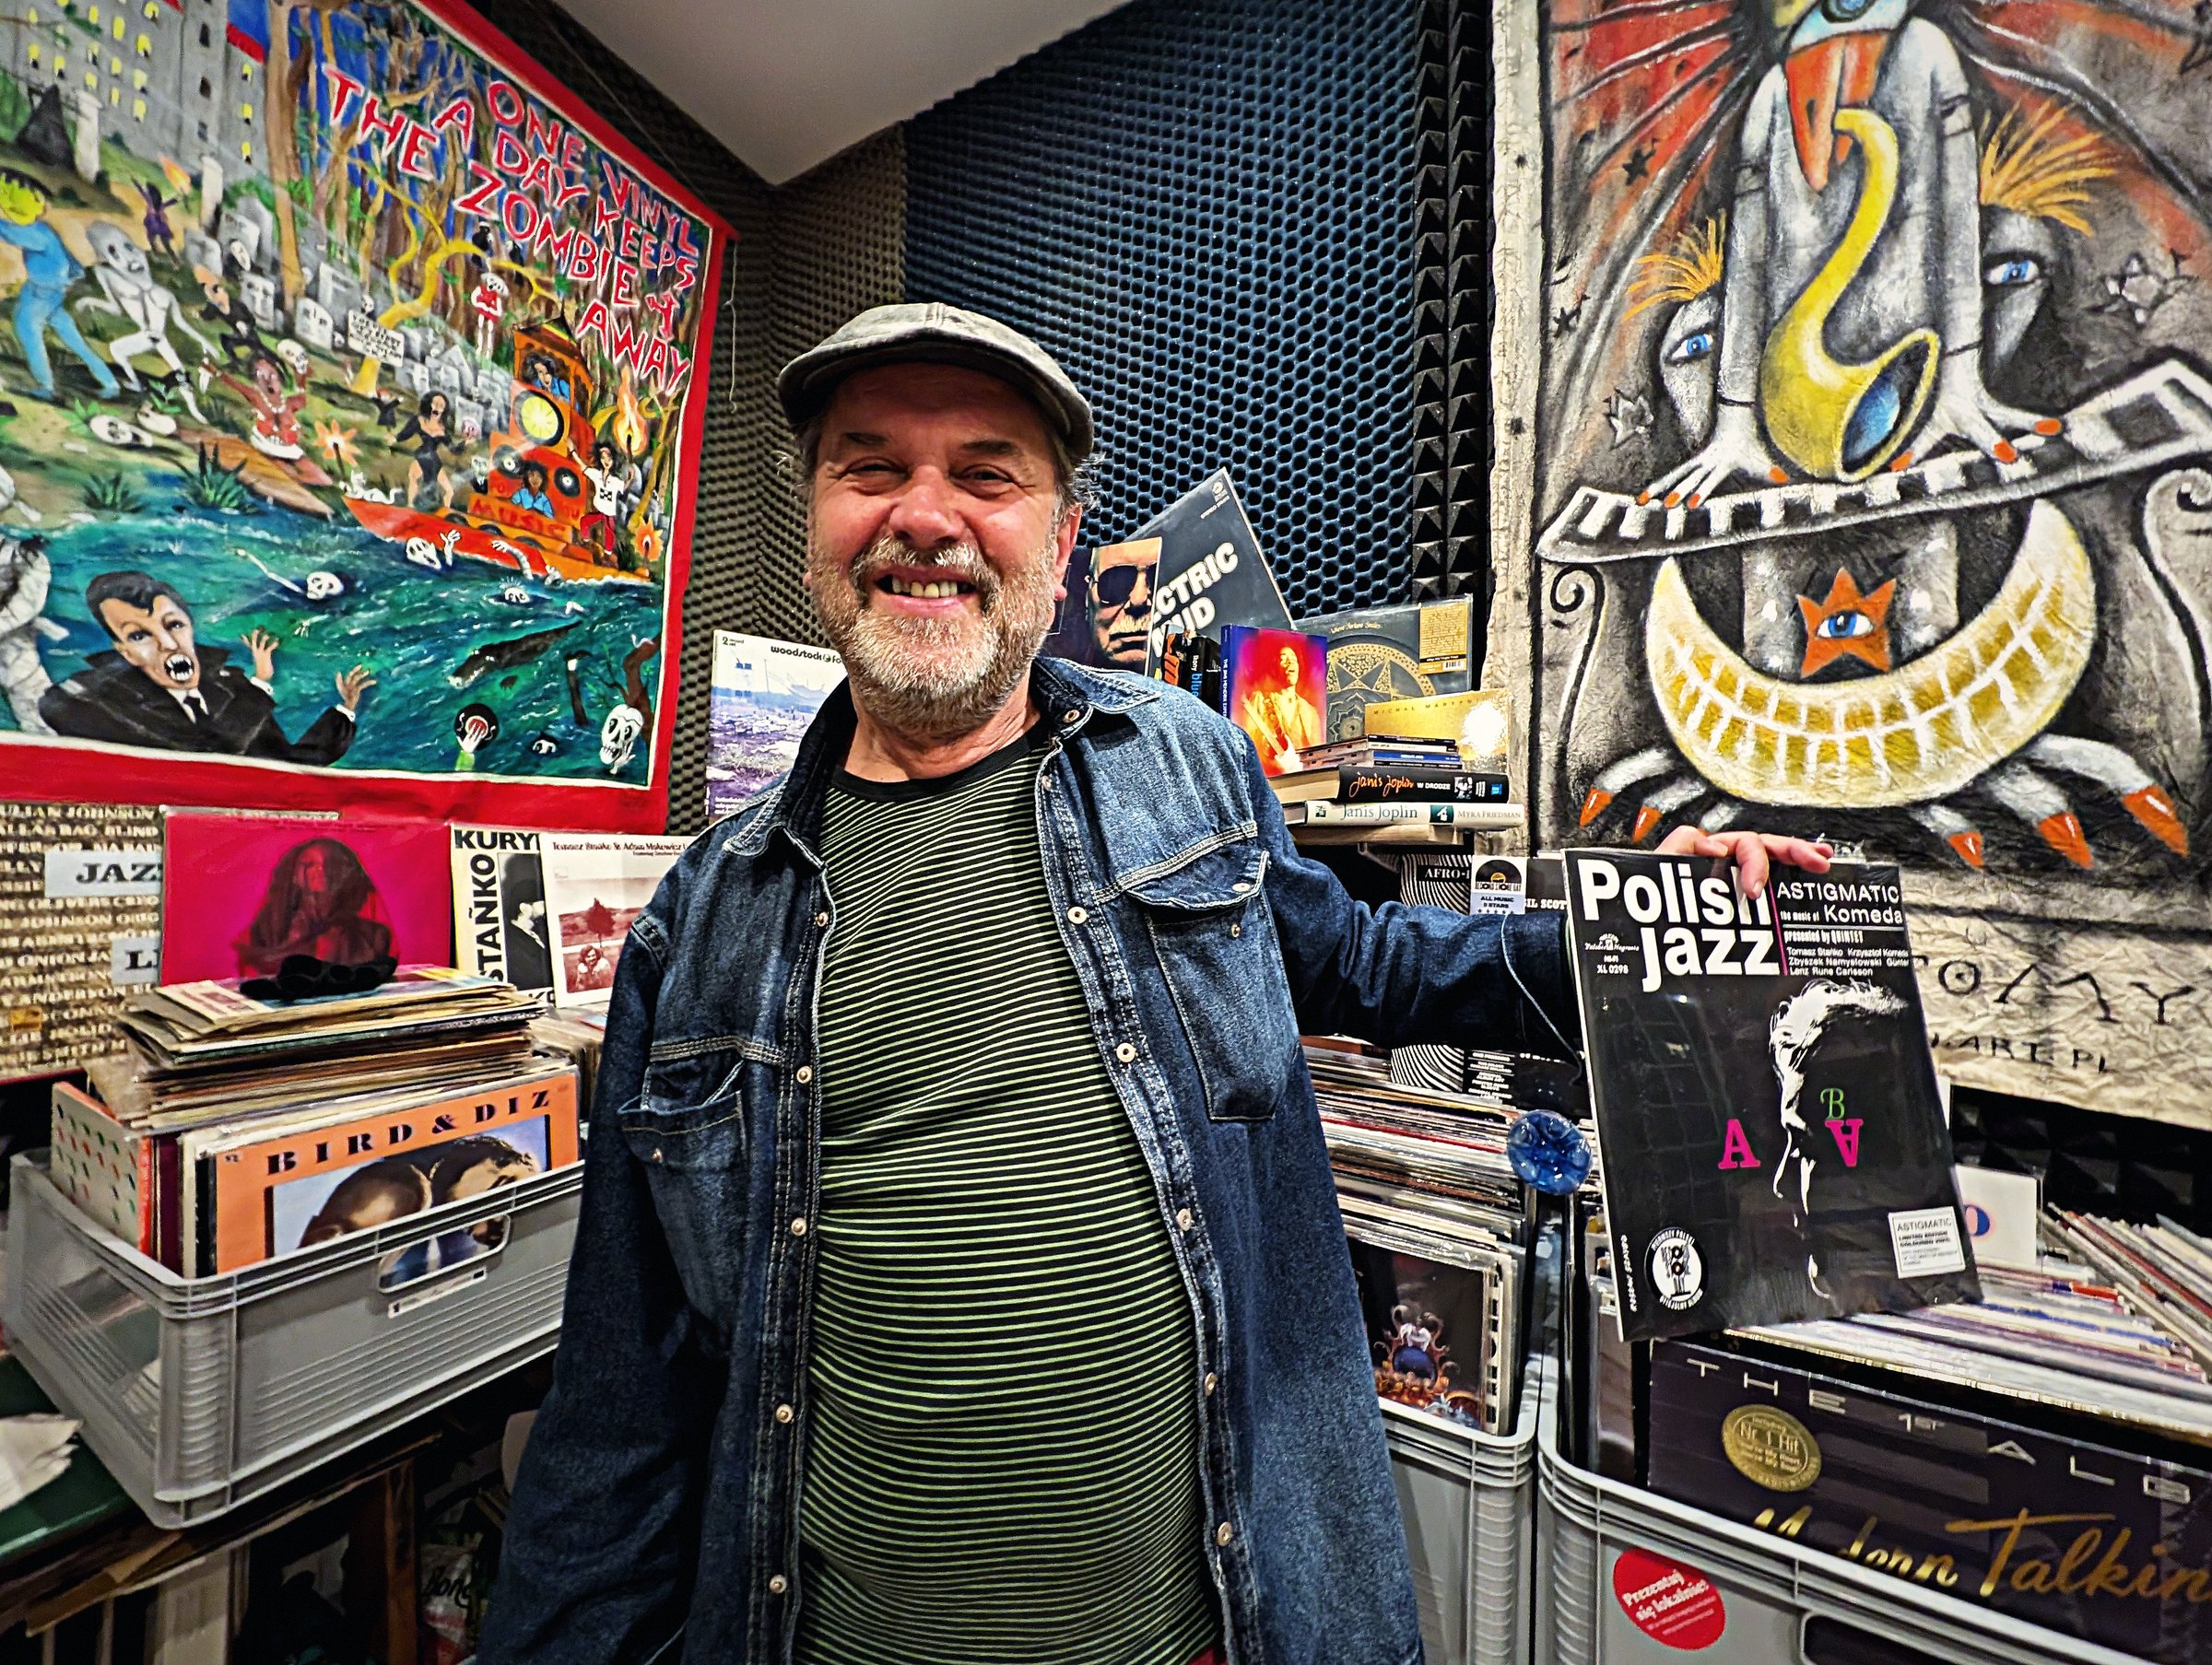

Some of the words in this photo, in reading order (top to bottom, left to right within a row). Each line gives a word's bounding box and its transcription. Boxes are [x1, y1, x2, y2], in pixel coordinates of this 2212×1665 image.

[487, 81, 587, 171] ONE
[602, 160, 699, 257] VINYL
[433, 97, 476, 154] A
[493, 127, 589, 209] DAY
[595, 197, 699, 291] KEEPS
[323, 64, 437, 182] THE
[454, 162, 640, 308] ZOMBIE
[574, 299, 690, 396] AWAY
[722, 637, 729, 645] 2
[771, 646, 822, 661] woodstock
[1191, 674, 1203, 697] blue
[1349, 772, 1382, 798] janis
[1382, 773, 1415, 798] joplin
[1425, 782, 1452, 791] DRODZE
[1341, 804, 1373, 819] Janis
[1376, 804, 1418, 821] Joplin
[1481, 811, 1522, 819] FRIEDMAN
[76, 863, 163, 884] JAZ
[1577, 859, 1772, 925] Polish
[1776, 882, 1900, 904] ASTIGMATIC
[1780, 910, 1791, 920] the
[1792, 910, 1811, 921] music
[1824, 904, 1903, 924] Komeda
[1783, 930, 1821, 944] presented
[1821, 930, 1830, 944] by
[1830, 930, 1864, 944] QUINTET
[1641, 926, 1780, 993] jazz
[1787, 946, 1816, 956] Tomasz
[1788, 957, 1824, 967] Zbyszek
[1596, 964, 1608, 974] XL
[1790, 967, 1809, 976] Lenz
[1812, 967, 1834, 976] Rune
[1835, 967, 1873, 977] Carlsson
[1819, 1087, 1846, 1120] B
[267, 1123, 414, 1176] BIRD
[430, 1113, 457, 1136] &
[474, 1089, 550, 1124] DIZ
[1717, 1119, 1761, 1170] A
[1824, 1118, 1864, 1168] A
[1897, 1217, 1952, 1232] ASTIGMATIC
[1687, 1357, 1846, 1414] THE
[1622, 1569, 1686, 1607] Prezentuj
